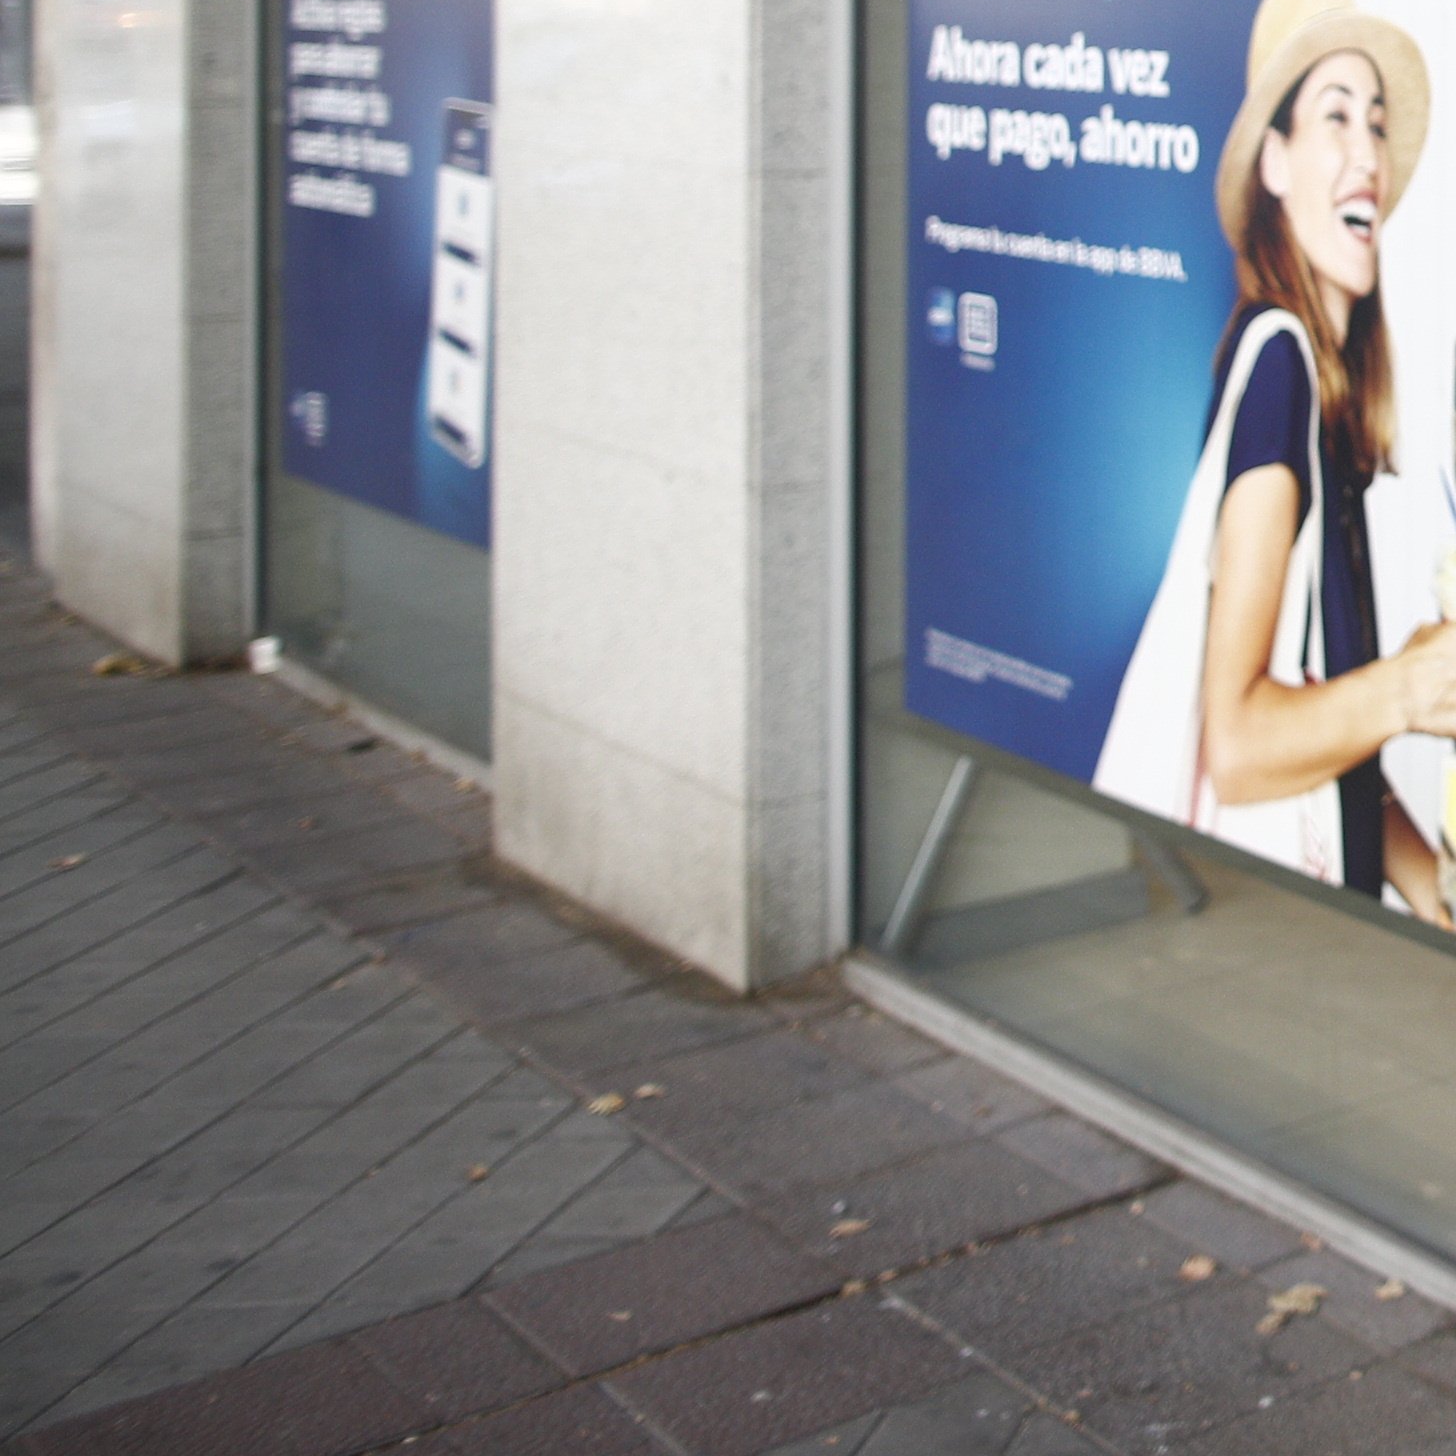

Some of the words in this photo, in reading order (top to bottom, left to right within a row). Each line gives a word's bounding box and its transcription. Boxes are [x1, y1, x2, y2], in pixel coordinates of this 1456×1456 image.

[926, 24, 1020, 87] Ahora
[1023, 30, 1104, 92] cada
[1107, 48, 1170, 97] vez
[926, 102, 987, 160] que
[988, 108, 1077, 170] pago,
[1079, 103, 1199, 173] ahorro
